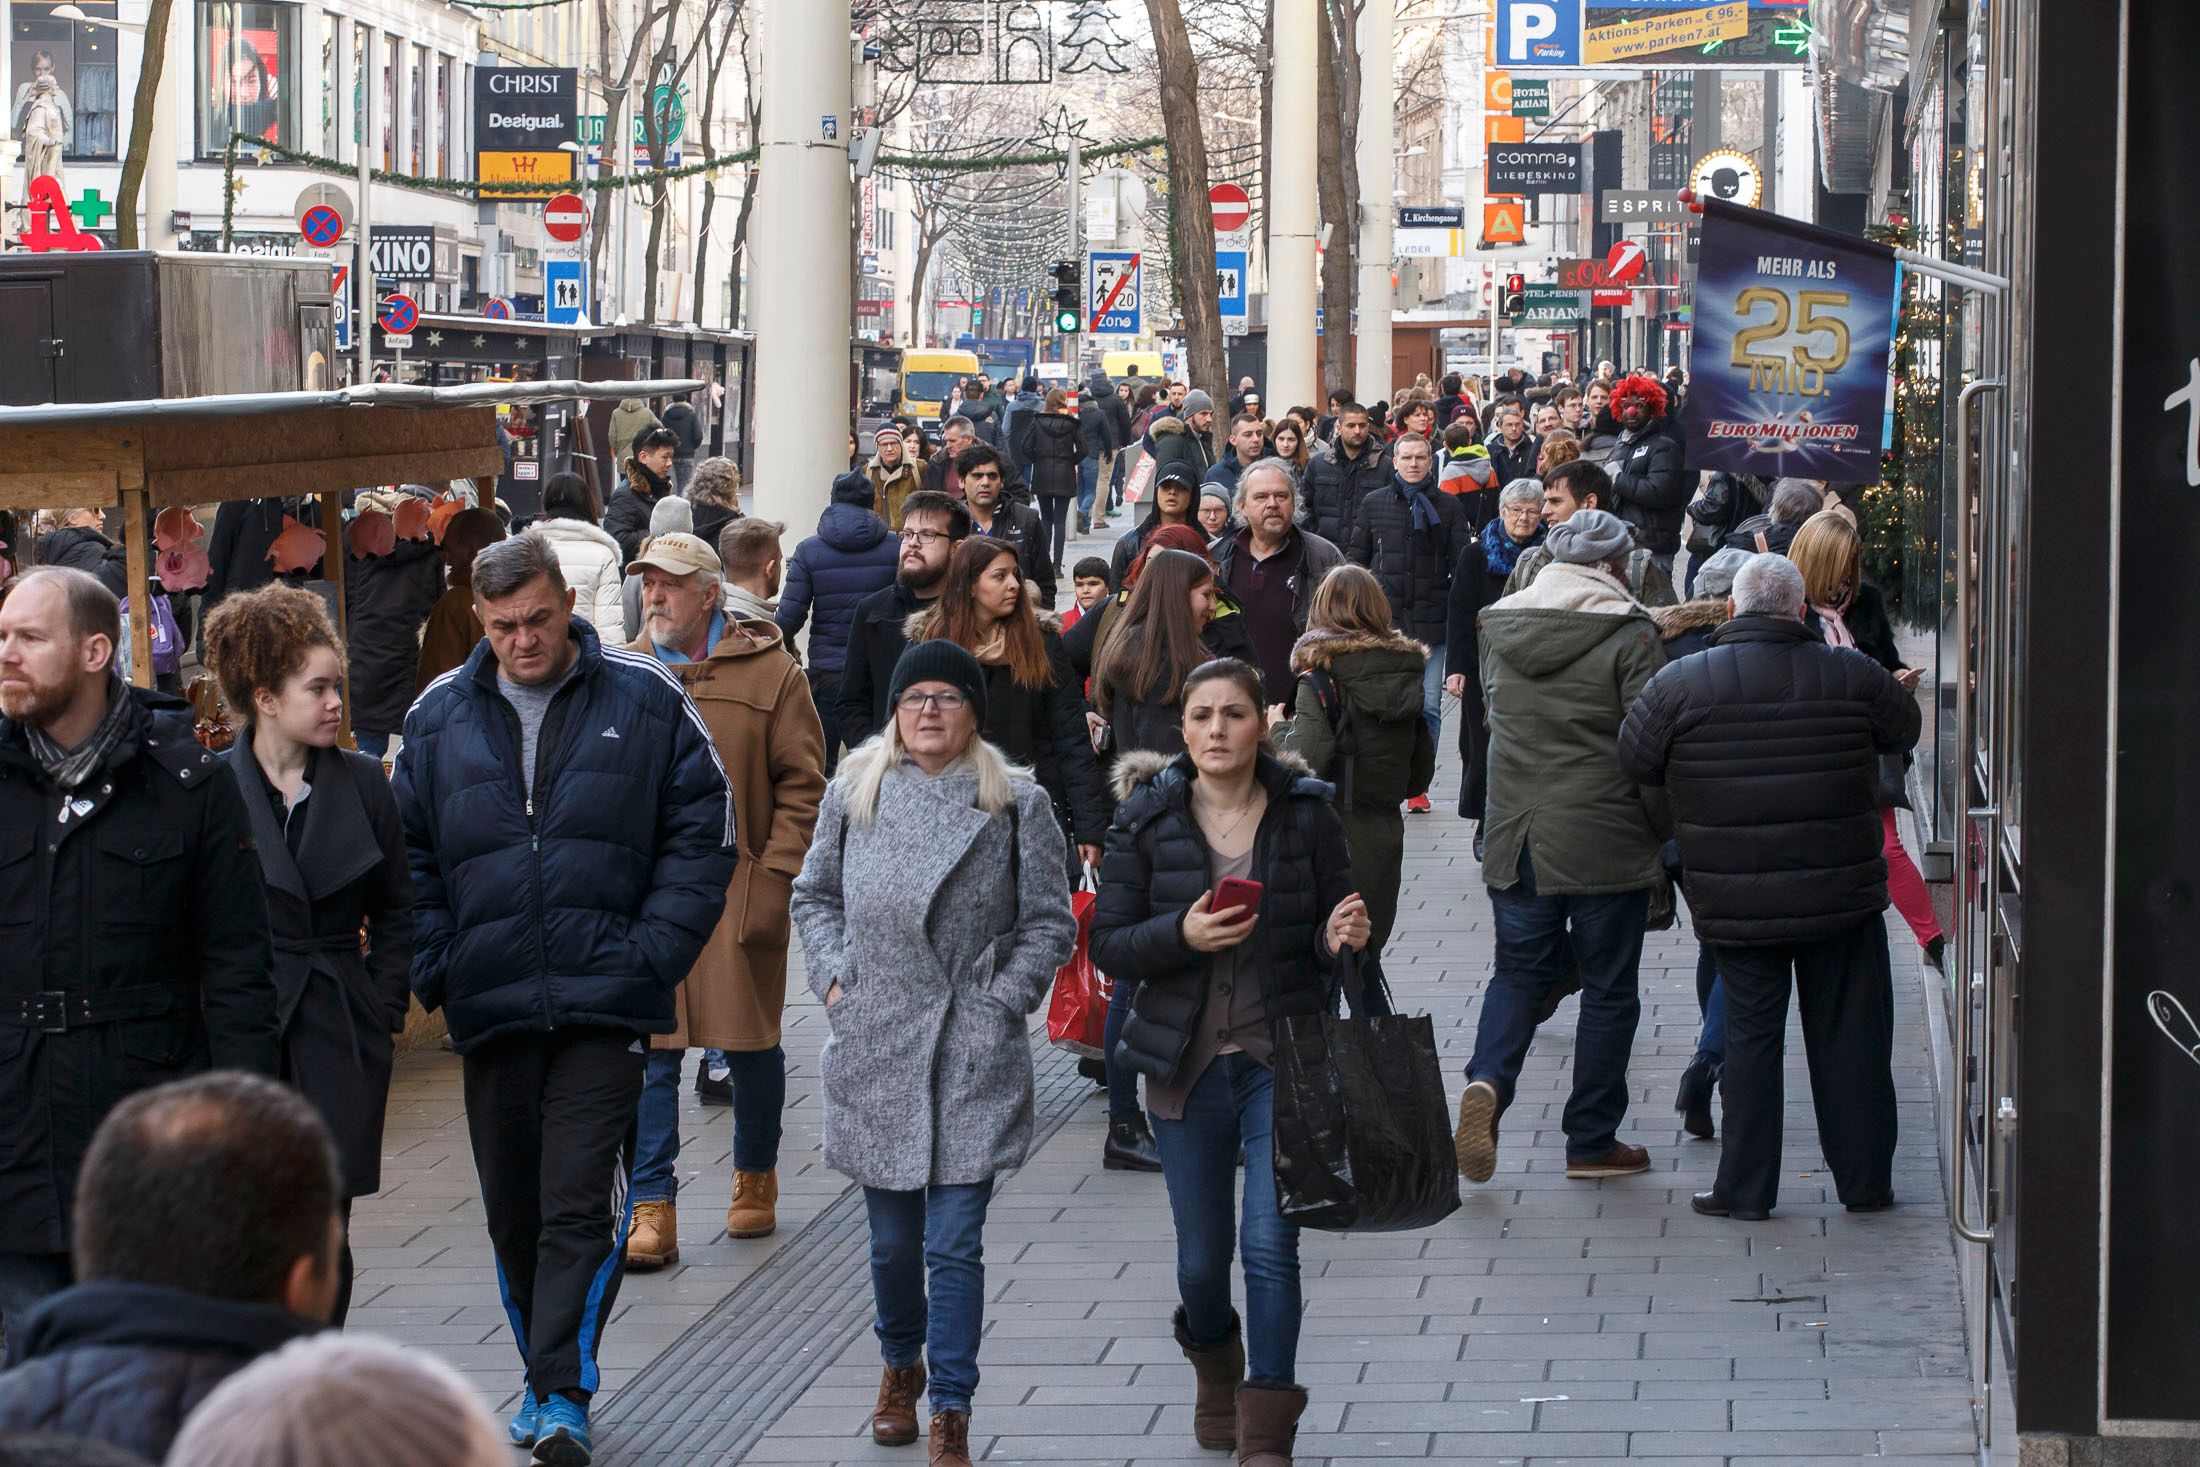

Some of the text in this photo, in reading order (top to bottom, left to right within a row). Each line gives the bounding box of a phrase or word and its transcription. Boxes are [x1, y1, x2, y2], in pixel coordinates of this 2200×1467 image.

[1509, 3, 1557, 60] P
[1588, 14, 1693, 43] Aktions-Parken
[1612, 26, 1720, 55] www.parken7.at
[489, 74, 561, 94] CHRIST
[1513, 88, 1548, 98] HOTEL
[1513, 99, 1548, 109] ARIAN
[1496, 152, 1576, 168] comma,
[1496, 171, 1576, 180] LIEBESKIND
[1608, 200, 1684, 213] ESPRIT
[1413, 214, 1458, 224] Kirchengasse
[369, 242, 431, 272] KINO
[1757, 256, 1837, 279] MEHR ALS
[1119, 293, 1134, 307] 20
[1731, 286, 1851, 374] 25
[1750, 359, 1831, 397] MIO.
